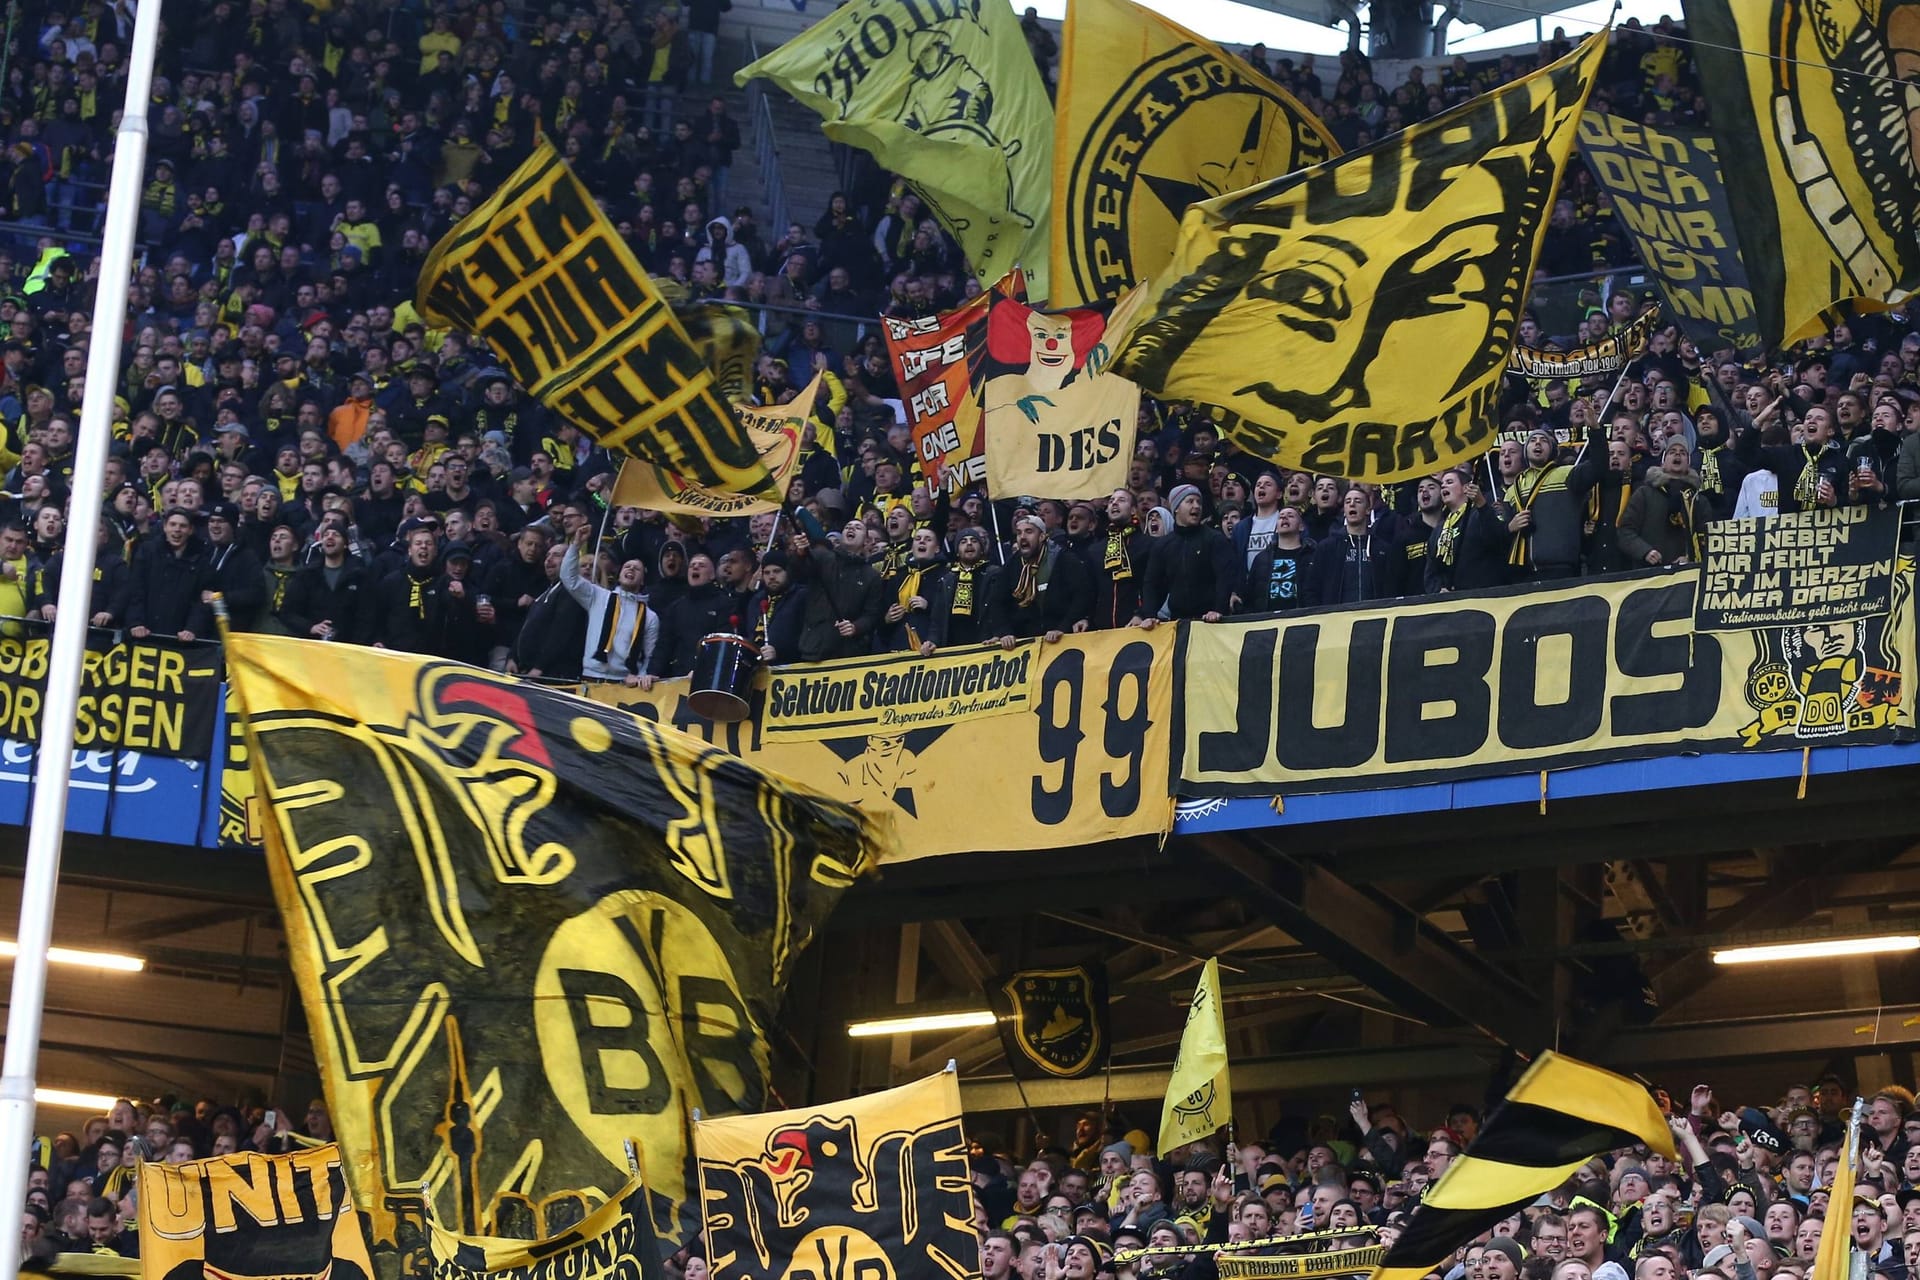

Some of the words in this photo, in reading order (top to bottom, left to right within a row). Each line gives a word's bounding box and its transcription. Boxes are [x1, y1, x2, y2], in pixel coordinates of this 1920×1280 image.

[1613, 194, 1727, 248] MIR
[900, 333, 966, 382] LIFE
[1532, 360, 1581, 376] DORTMUND
[1583, 361, 1598, 372] VON
[911, 381, 949, 423] FOR
[921, 420, 960, 463] ONE
[1036, 418, 1121, 473] DES
[927, 454, 986, 500] LVE
[1706, 517, 1757, 534] DER
[1764, 505, 1868, 531] FREUND
[1708, 535, 1755, 553] DER
[1764, 526, 1849, 550] NEBEN
[1706, 574, 1745, 592] IST
[1753, 571, 1781, 591] IM
[1790, 559, 1891, 588] HERZEN
[1707, 554, 1751, 573] MIR
[1760, 546, 1835, 571] FEHLT
[1703, 590, 1783, 610] IMMER
[1792, 581, 1867, 606] DABEI
[0, 637, 214, 695] SBRGER-
[769, 669, 853, 719] Sektion
[860, 650, 1031, 710] Stadionverbot
[1199, 581, 1723, 772] JUBOS
[881, 705, 944, 727] Desperados
[945, 691, 1010, 717] Dortmund
[1775, 705, 1797, 721] 19
[1805, 697, 1840, 724] DO
[1850, 711, 1875, 728] 09
[1031, 640, 1155, 826] 99
[143, 1145, 352, 1240] UNIT
